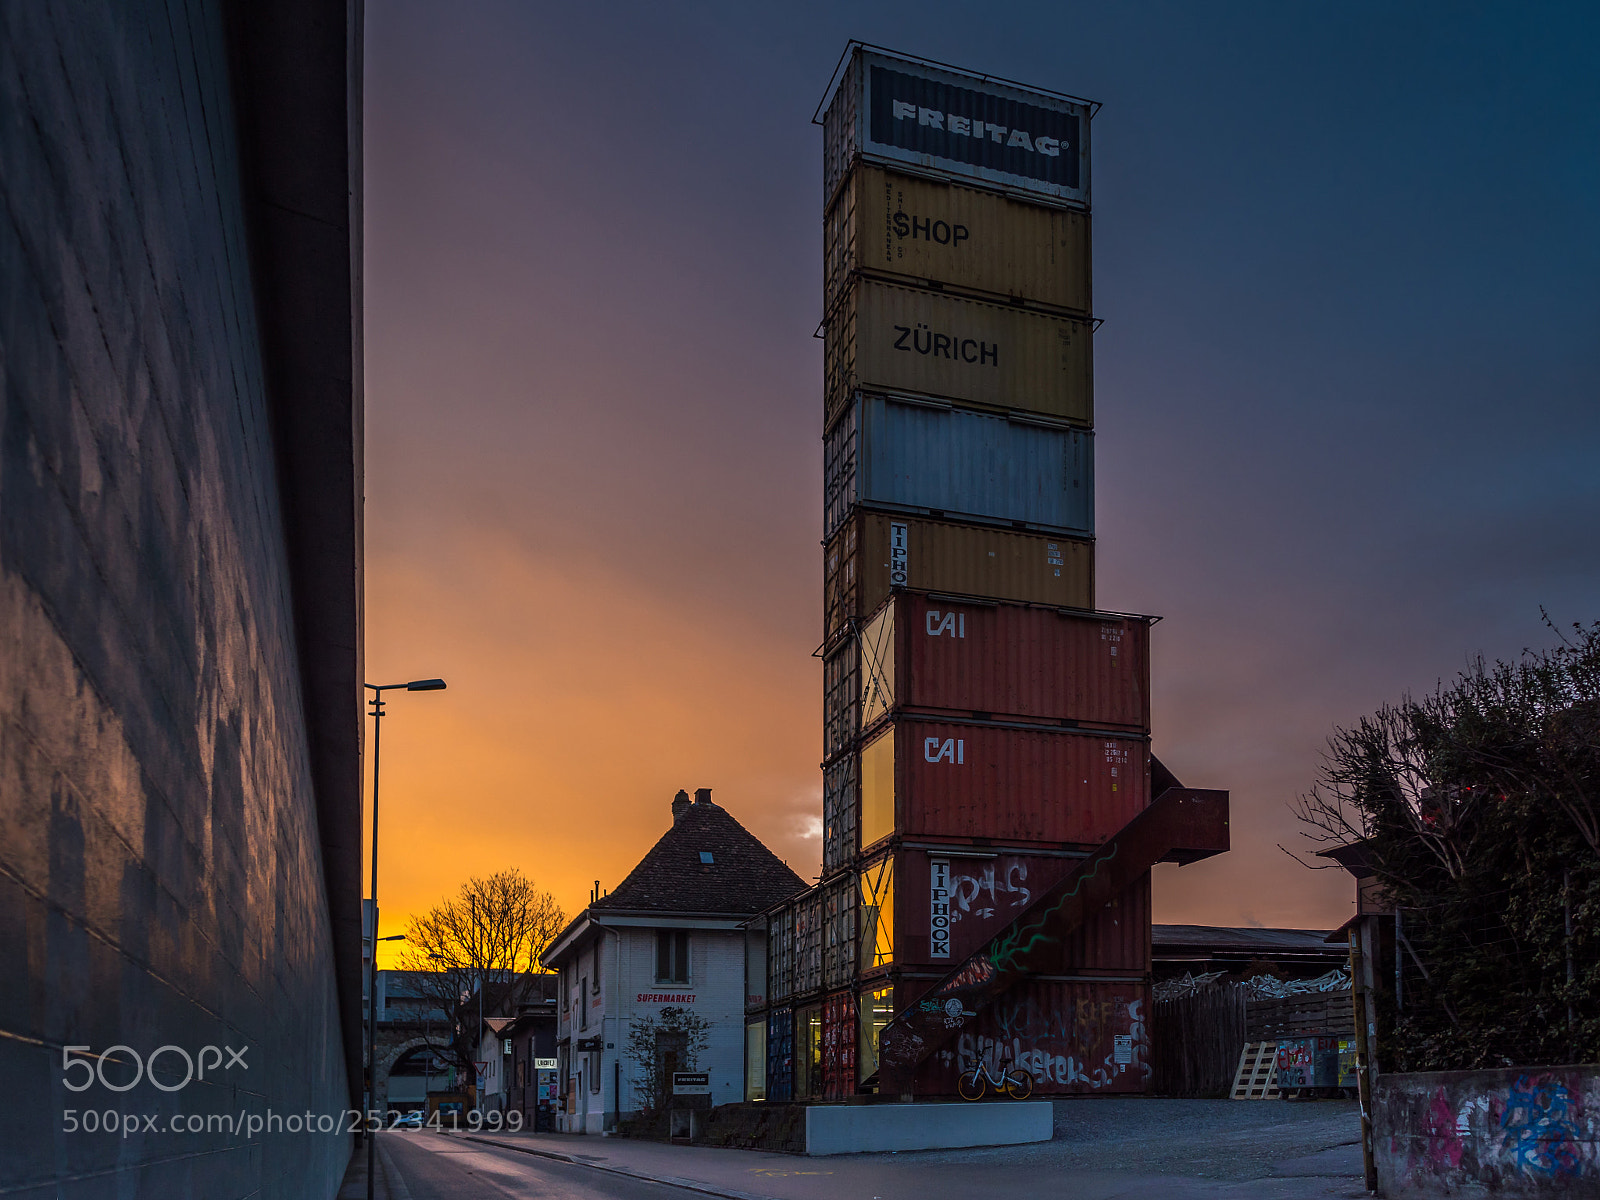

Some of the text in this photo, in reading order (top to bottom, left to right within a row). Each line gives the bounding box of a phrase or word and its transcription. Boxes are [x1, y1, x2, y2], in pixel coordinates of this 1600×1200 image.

[893, 211, 969, 248] SHOP
[893, 323, 998, 367] ZÜRICH
[926, 610, 965, 638] CAI
[924, 737, 964, 764] CAI
[931, 861, 949, 955] TIPHOOK
[636, 993, 697, 1004] SUPERMARKET
